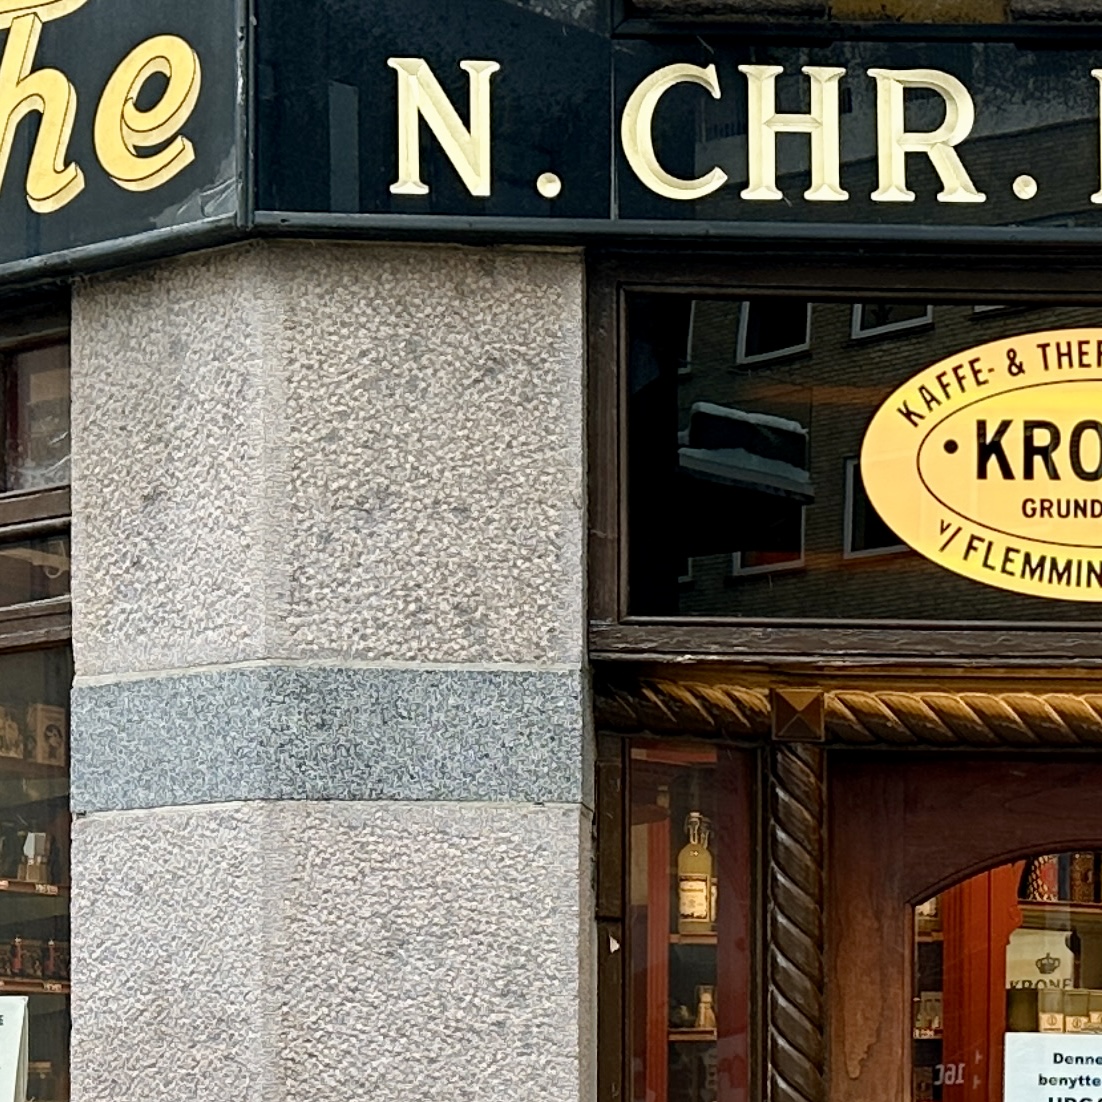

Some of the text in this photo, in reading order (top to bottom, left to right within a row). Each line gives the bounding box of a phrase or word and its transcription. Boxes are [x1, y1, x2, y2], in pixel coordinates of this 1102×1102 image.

[0, 0, 201, 214] he
[386, 57, 562, 197] N.
[620, 62, 1038, 203] CHR.
[896, 356, 997, 428] KAFFE-
[1007, 348, 1026, 376] &
